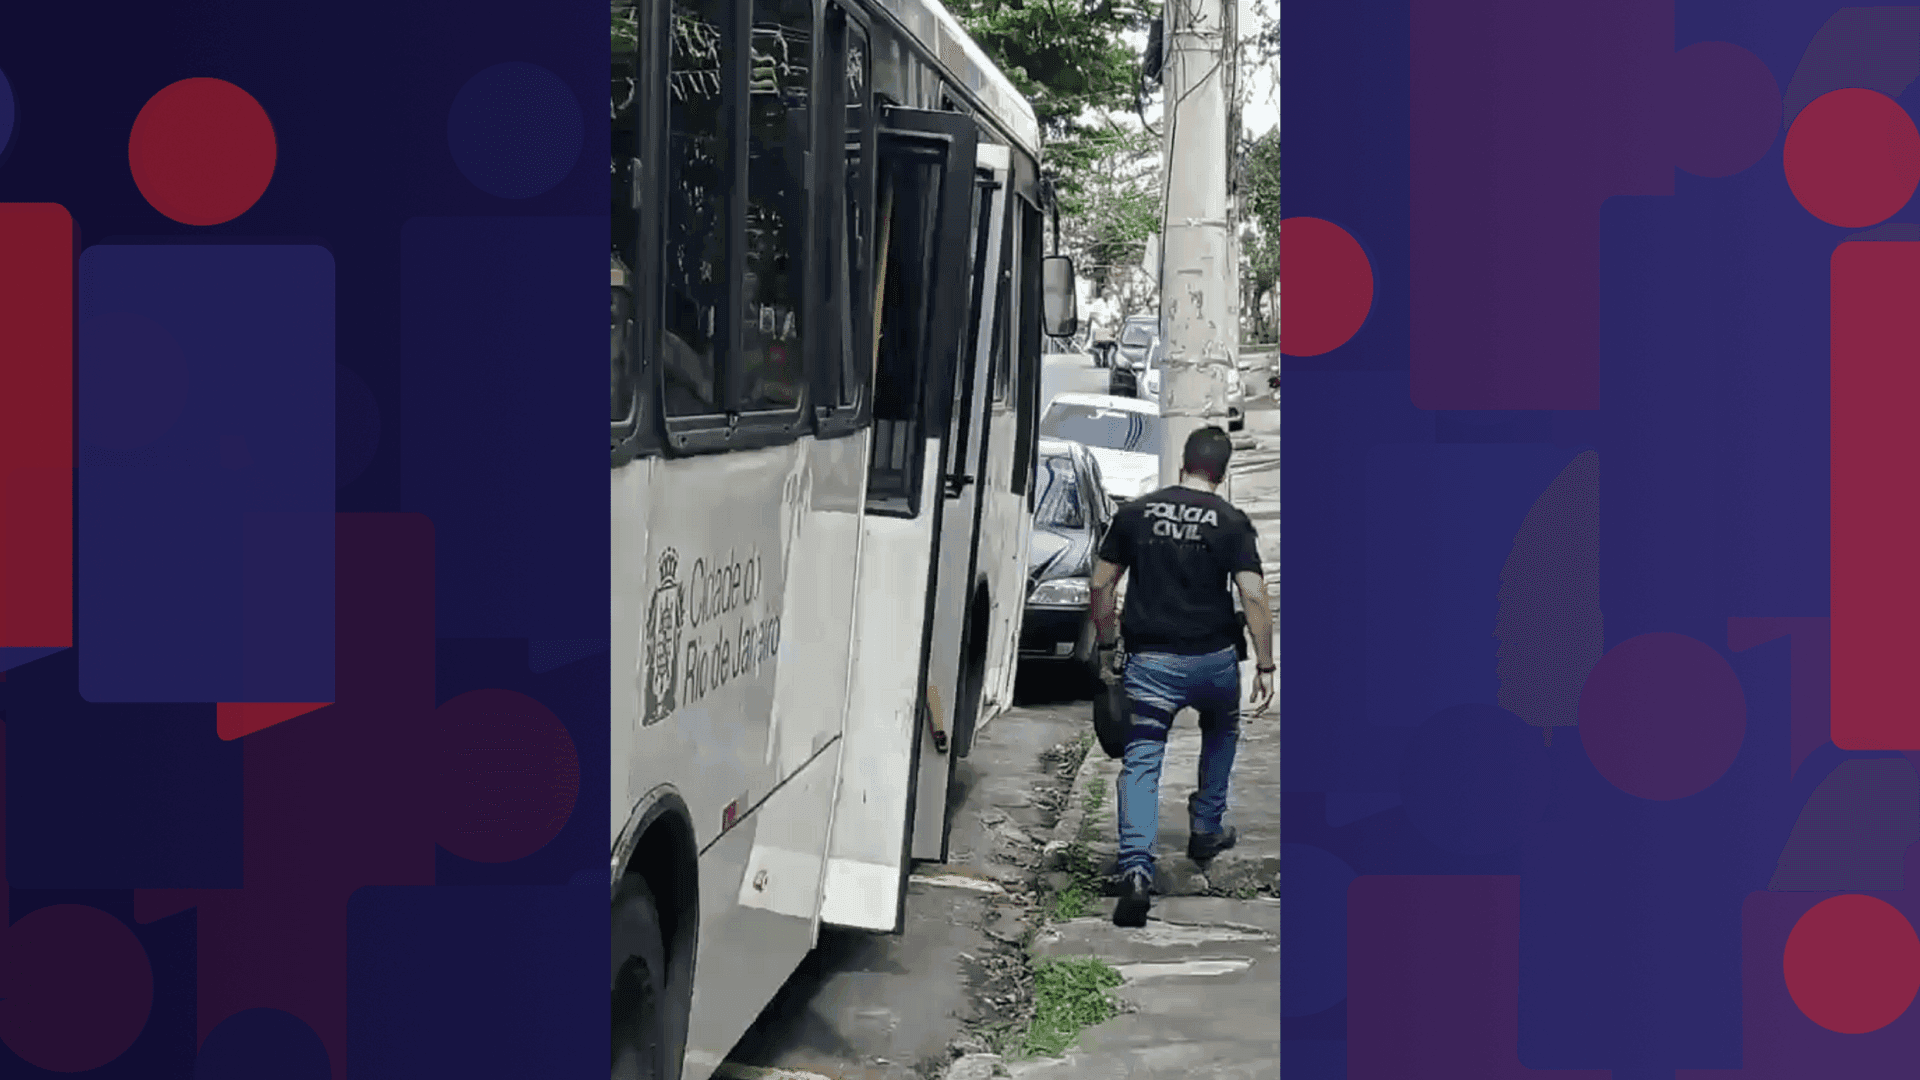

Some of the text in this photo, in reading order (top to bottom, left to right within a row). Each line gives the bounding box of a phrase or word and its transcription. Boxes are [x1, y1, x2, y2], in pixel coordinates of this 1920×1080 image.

[1152, 519, 1202, 540] CIVIL
[690, 547, 742, 628] Cidade
[683, 603, 781, 708] Rio de Janeiro
